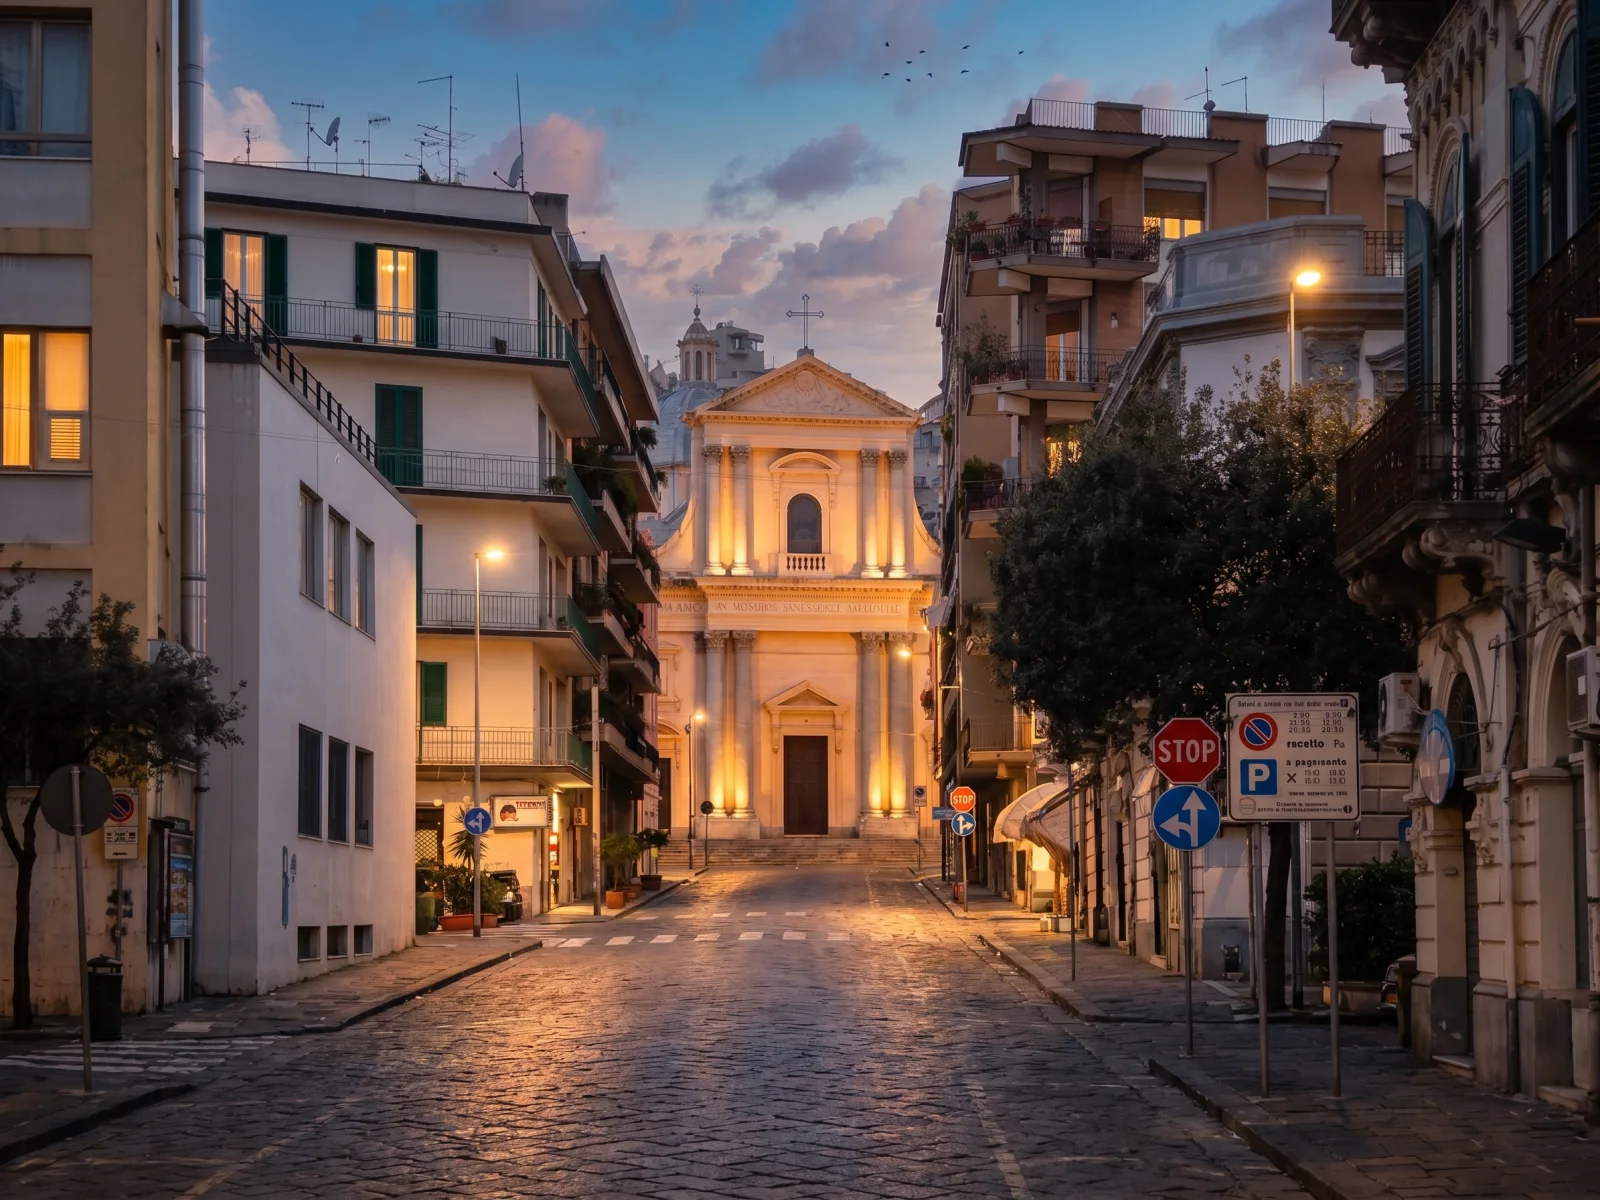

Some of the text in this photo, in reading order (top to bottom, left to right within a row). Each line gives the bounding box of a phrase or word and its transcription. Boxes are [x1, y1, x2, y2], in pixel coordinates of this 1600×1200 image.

[1158, 739, 1216, 763] STOP
[1248, 763, 1270, 791] P
[953, 795, 974, 804] STOP
